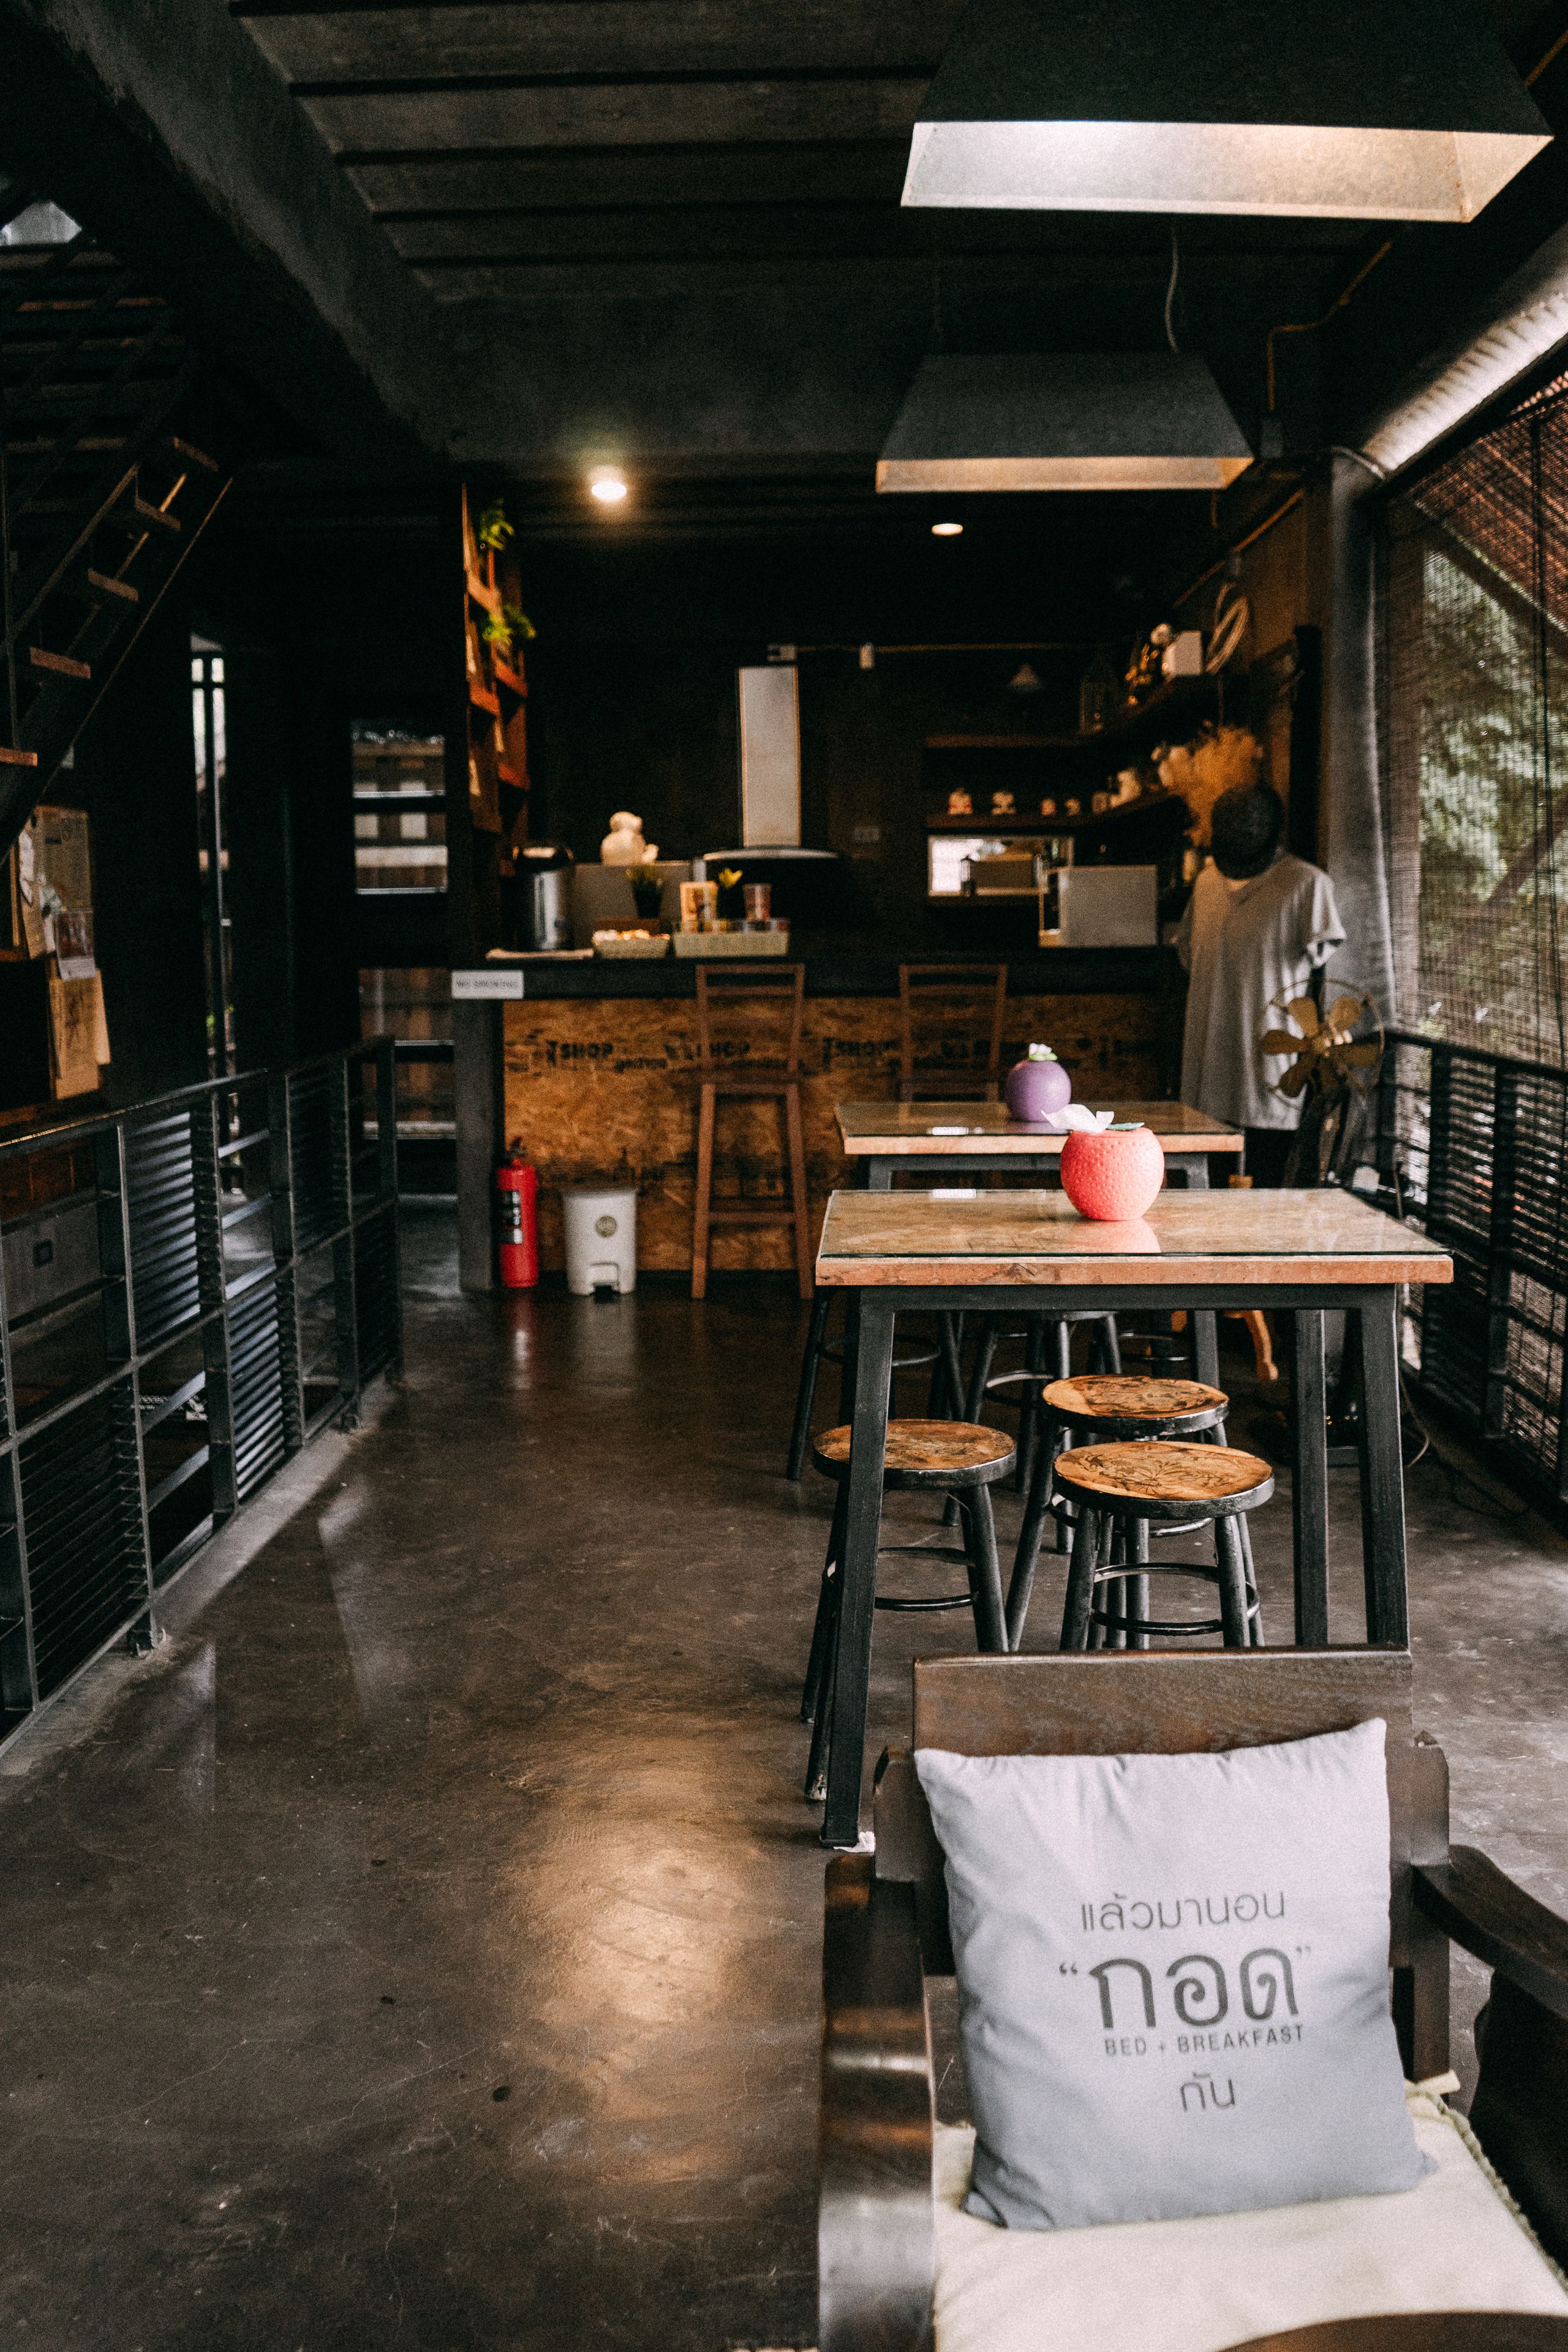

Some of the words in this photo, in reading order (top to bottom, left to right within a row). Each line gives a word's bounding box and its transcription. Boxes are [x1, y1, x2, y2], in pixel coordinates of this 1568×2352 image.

[1080, 1891, 1285, 1932] แล้วมานอน
[1104, 2037, 1148, 2057] BED
[1177, 2024, 1304, 2054] BREAKFAST
[1180, 2073, 1236, 2112] กัน
